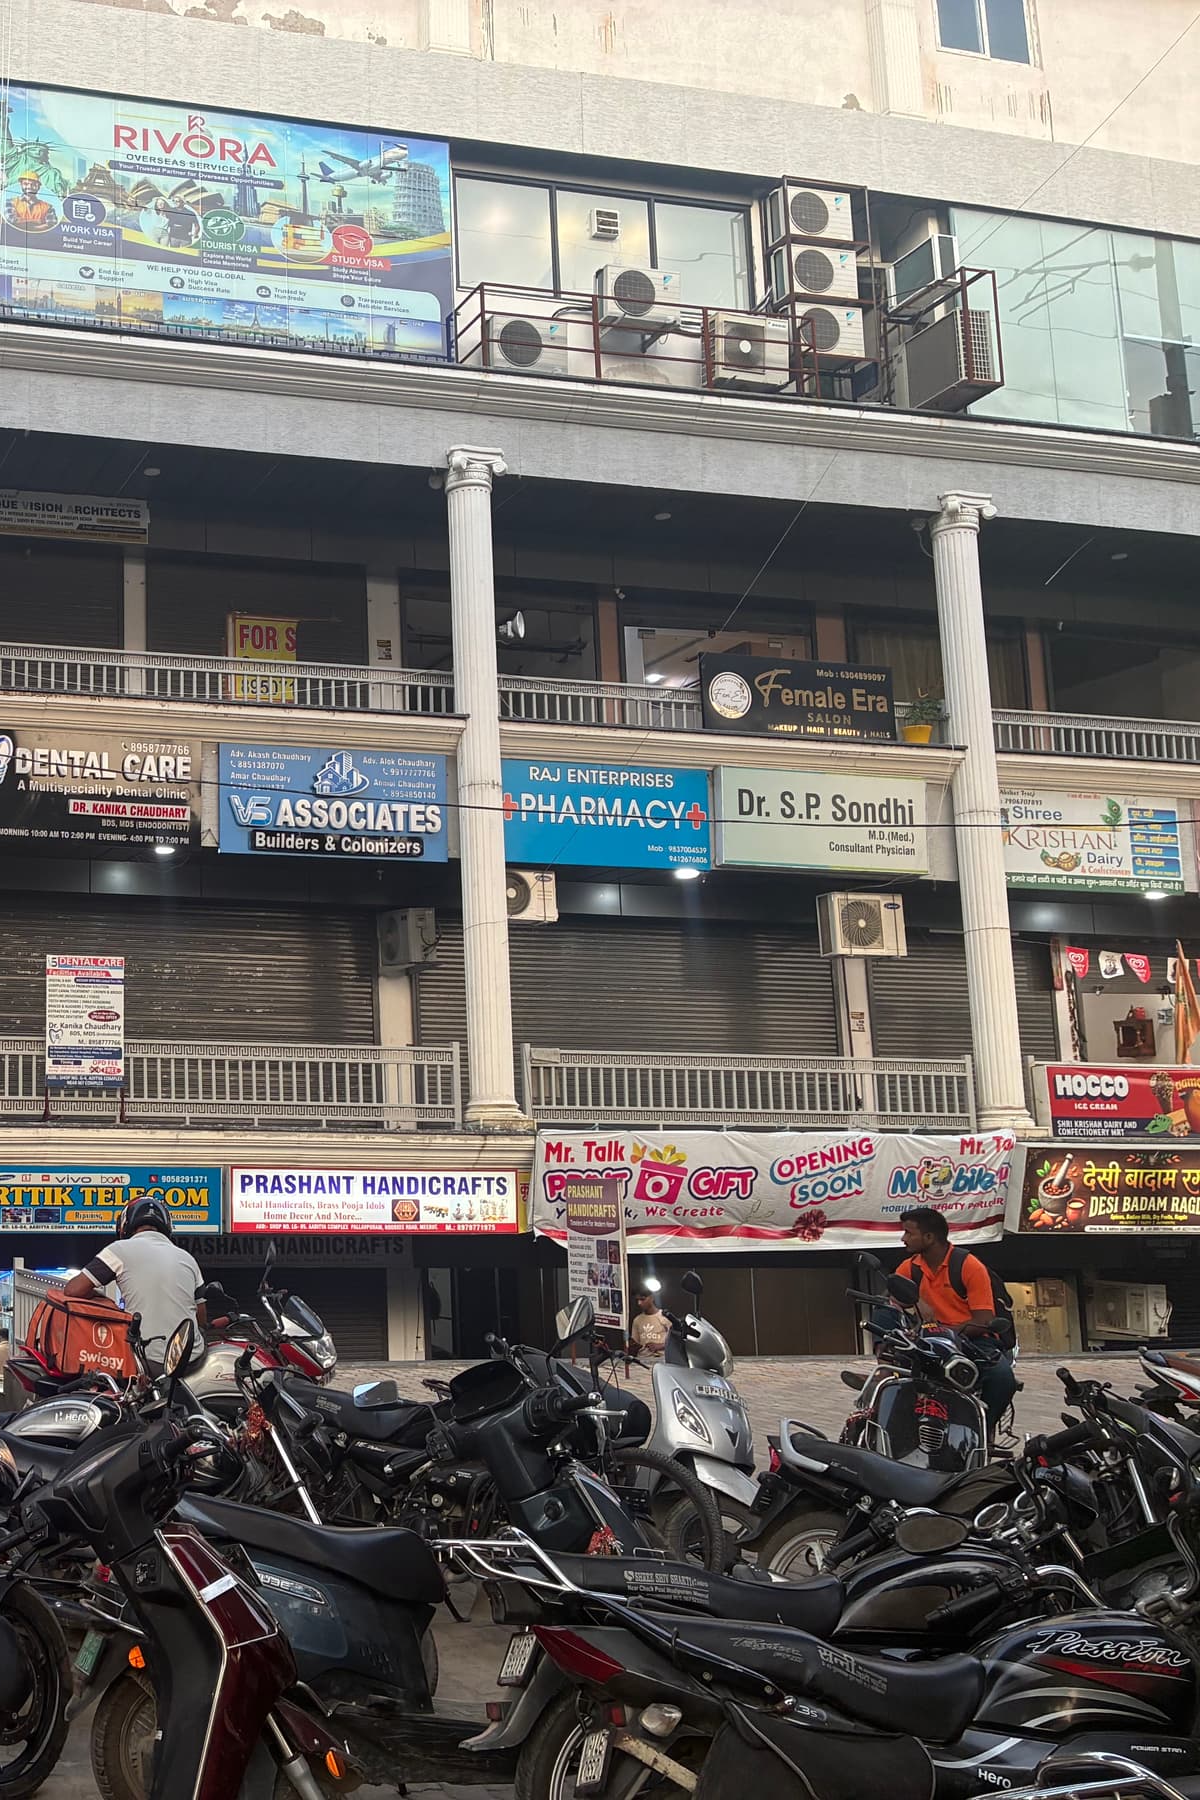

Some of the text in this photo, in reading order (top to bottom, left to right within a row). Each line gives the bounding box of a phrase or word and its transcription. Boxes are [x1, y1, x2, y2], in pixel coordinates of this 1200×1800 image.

[114, 125, 277, 167] RIVORA
[127, 154, 186, 167] OVERSEAS
[61, 225, 113, 237] WORK VISA
[202, 241, 258, 253] TOURIST VISA
[332, 255, 383, 267] STUDY VISA
[161, 265, 180, 273] HELP
[183, 267, 199, 276] YOU
[214, 271, 245, 281] GLOBAL
[23, 502, 62, 512] VISION
[67, 506, 141, 518] ARCHITECTS
[240, 625, 278, 650] FOR
[754, 669, 888, 713] Female Era
[808, 713, 852, 725] SALON
[15, 748, 192, 783] DENTAL CARE
[529, 767, 673, 788] RAJ ENTERPRISES
[17, 780, 186, 799] A Multispeciality Dental Clinic
[73, 802, 186, 818] DR. KANIKA CHAUDHARY
[276, 799, 441, 833] ASSOCIATES
[521, 793, 685, 829] PHARMACY
[738, 789, 913, 825] Dr. S.P. Sondhi
[1013, 806, 1062, 821] Shree
[255, 832, 421, 854] Builders & Colonizers
[1008, 826, 1113, 850] KRISHAN
[829, 842, 915, 857] Consultant Physician
[1088, 853, 1123, 867] Dairy
[60, 957, 95, 965] DENTAL
[1054, 1073, 1130, 1100] HOCCO
[1058, 1120, 1137, 1129] SHRI KRISHAN DAIRY AND
[1058, 1128, 1108, 1136] CONFECTIONERY
[545, 1141, 624, 1163] Mr. Talk
[778, 1137, 874, 1179] OPENING
[240, 1175, 508, 1196] PRASHANT HANDICRAFTS
[693, 1171, 754, 1199] GIFT
[797, 1171, 863, 1202] SOON
[1083, 1160, 1178, 1195] देसी बादाम
[80, 1187, 209, 1207] TELECOM
[567, 1185, 603, 1199] PRASHANT
[264, 1212, 362, 1221] Home Decor And More...
[265, 1201, 315, 1211] Handicrafts,
[342, 1202, 363, 1212] Pooja
[366, 1202, 385, 1210] Idols
[568, 1203, 616, 1218] HANDICRAFTS
[645, 1205, 724, 1217] We Create
[1089, 1197, 1118, 1217] DESI
[1122, 1197, 1168, 1212] BADAM
[79, 1349, 124, 1370] Swiggy
[65, 1412, 87, 1422] Hero
[1027, 1630, 1191, 1667] Passion
[978, 1768, 1011, 1789] Hero
